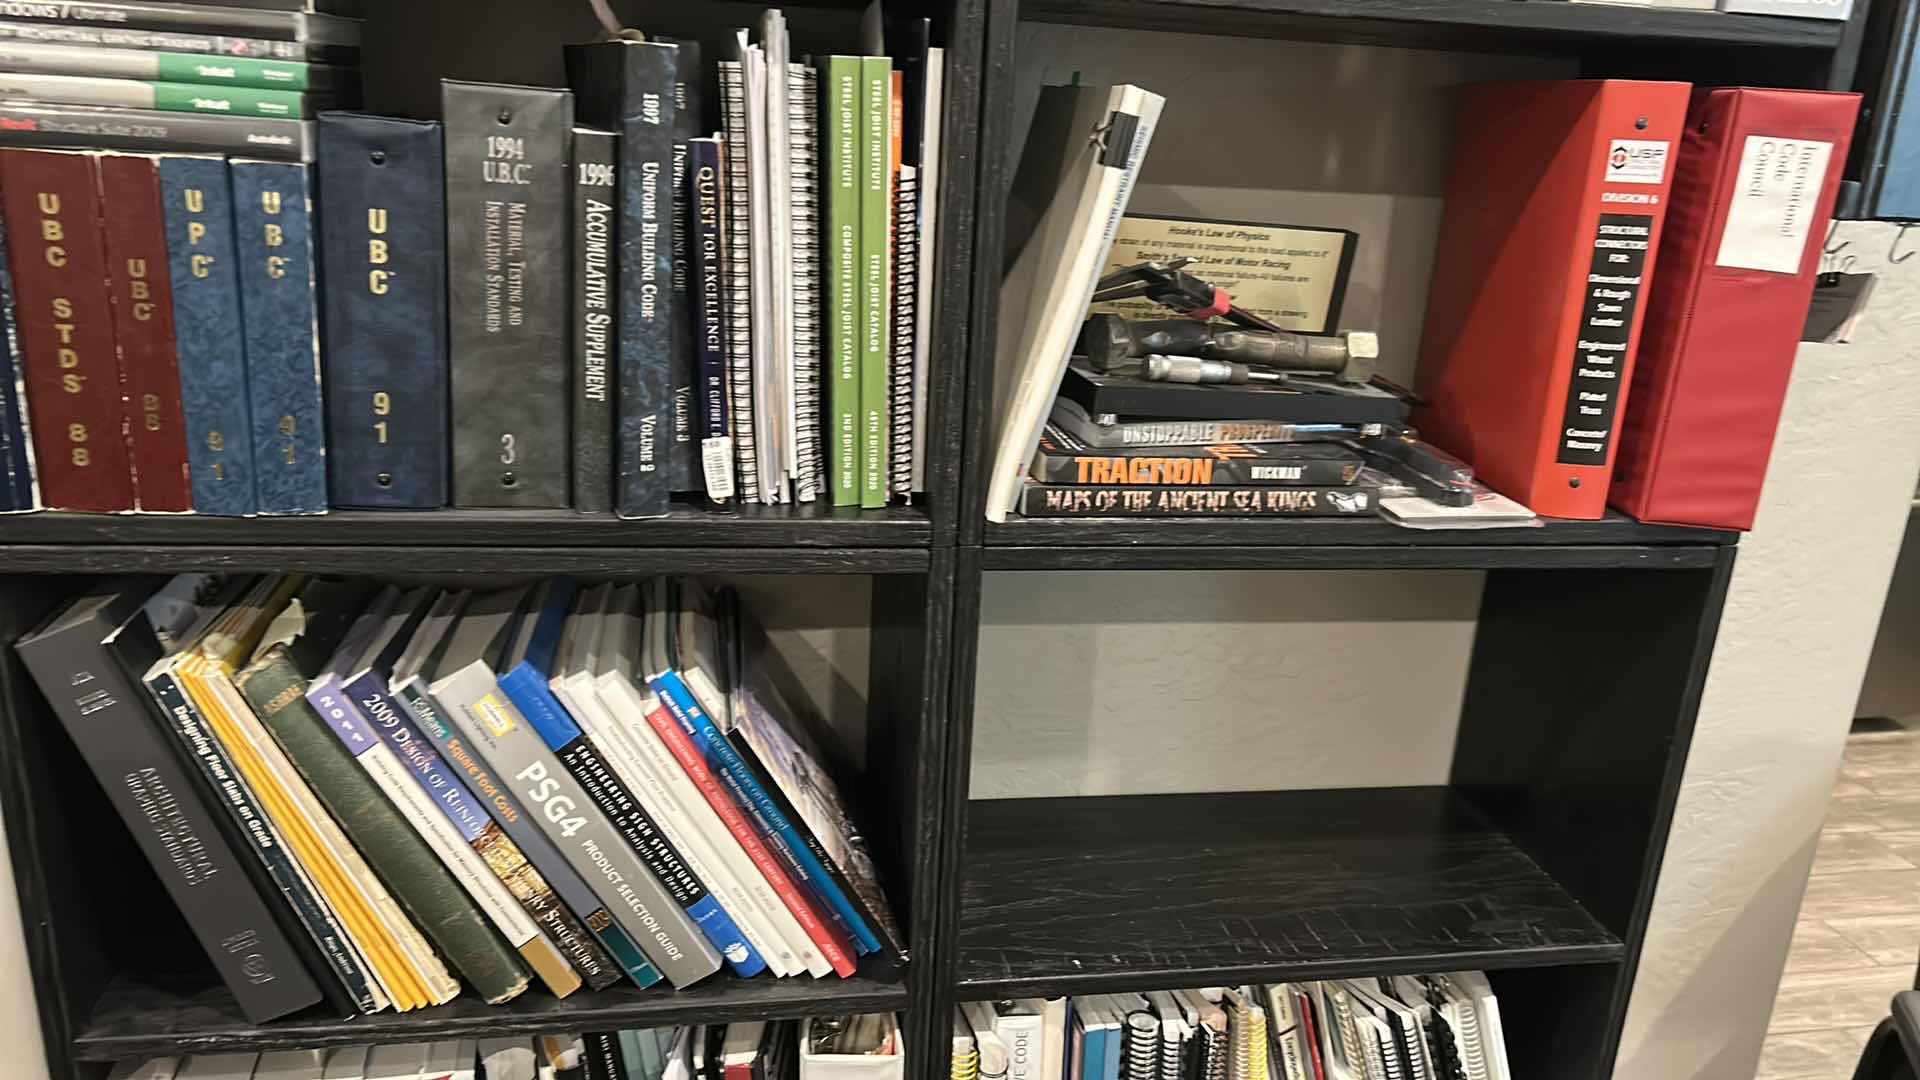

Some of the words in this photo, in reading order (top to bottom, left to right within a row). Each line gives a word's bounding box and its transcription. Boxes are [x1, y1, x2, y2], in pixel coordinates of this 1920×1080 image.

[841, 76, 853, 105] STEEL
[871, 79, 883, 107] STEEL
[841, 107, 853, 134] JOIST
[870, 110, 882, 136] JOIST
[487, 136, 524, 160] 1994
[841, 137, 853, 187] INSTITUTE
[871, 140, 882, 190] INSTITUTE
[1747, 141, 1776, 197] Council
[1773, 143, 1799, 182] Code
[579, 163, 614, 186] 1996
[641, 162, 660, 219] UNIFORM
[699, 166, 717, 228] QUEST
[1779, 146, 1819, 238] International
[1601, 193, 1648, 203] DIVISION
[38, 192, 67, 267] UBC
[184, 189, 209, 279] UPC
[262, 191, 287, 280] UBC
[368, 208, 391, 294] UBC
[485, 200, 505, 270] INSTALLATION
[641, 223, 659, 280] BUILDING
[703, 233, 716, 260] FOR
[842, 225, 853, 279] COMPOSITE
[1206, 228, 1224, 238] Law
[1226, 229, 1236, 239] of
[1236, 230, 1270, 244] Physics
[585, 199, 613, 308] ACCUMULATIVE
[870, 254, 881, 280] STEEL
[1205, 255, 1223, 264] Law
[1224, 256, 1235, 265] of
[128, 258, 153, 321] UBC
[507, 261, 527, 302] TESTING
[640, 284, 658, 318] CODE
[842, 281, 853, 308] STEEL
[869, 283, 880, 307] JOIST
[508, 305, 523, 325] AND
[704, 265, 721, 352] EXCELLENCE
[841, 310, 853, 334] JOIST
[869, 310, 880, 352] CATALOG
[52, 297, 82, 393] STDS
[585, 313, 612, 402] SUPPLEMENT
[842, 337, 853, 379] CATALOG
[373, 392, 391, 443] 91
[676, 386, 690, 432] VOLUME
[709, 390, 722, 422] CLIFFORD
[69, 423, 91, 466] 88
[501, 434, 515, 464] 3
[640, 415, 656, 461] VOLUME
[842, 434, 853, 468] EDITION
[868, 435, 878, 469] EDITION
[1123, 425, 1214, 444] UNSTOPPABLE
[1075, 457, 1215, 485] TRACTION
[1251, 466, 1302, 480] WICKMAN
[1047, 490, 1092, 512] MAPS
[1096, 490, 1117, 508] OF
[1122, 491, 1152, 511] THE
[1158, 490, 1230, 511] ANCIENT
[1234, 490, 1262, 510] SEA
[1268, 490, 1317, 510] KINGS
[174, 706, 211, 755] Designing
[208, 752, 229, 782] Floor
[222, 780, 244, 806] Slabs
[239, 805, 253, 820] on
[249, 818, 273, 848] Grade
[447, 739, 480, 780] Square
[475, 774, 497, 799] Foot
[494, 794, 519, 824] Costs
[703, 725, 737, 764] Concrete
[728, 760, 757, 789] Floors
[756, 799, 789, 831] Ground
[140, 767, 218, 880] ARCHITECTURAL
[363, 694, 400, 728] 2009
[392, 727, 433, 774] DESIGN
[429, 774, 447, 792] OF
[544, 908, 600, 976] STRUCTURES
[563, 752, 578, 767] An
[575, 765, 619, 816] Introduction
[615, 813, 627, 828] to
[624, 827, 651, 861] Analysis
[651, 858, 667, 876] and
[665, 874, 689, 902] Design
[575, 744, 632, 812] ENGINEERING
[628, 811, 653, 839] SIGN
[650, 837, 700, 896] STRUCTURES
[154, 823, 203, 886] STANDARDS
[515, 760, 588, 838] PSG4
[581, 839, 622, 885] PRODUCT
[617, 880, 658, 934] SELECTION
[653, 931, 685, 962] GUIDE
[1017, 1030, 1029, 1064] CODE
